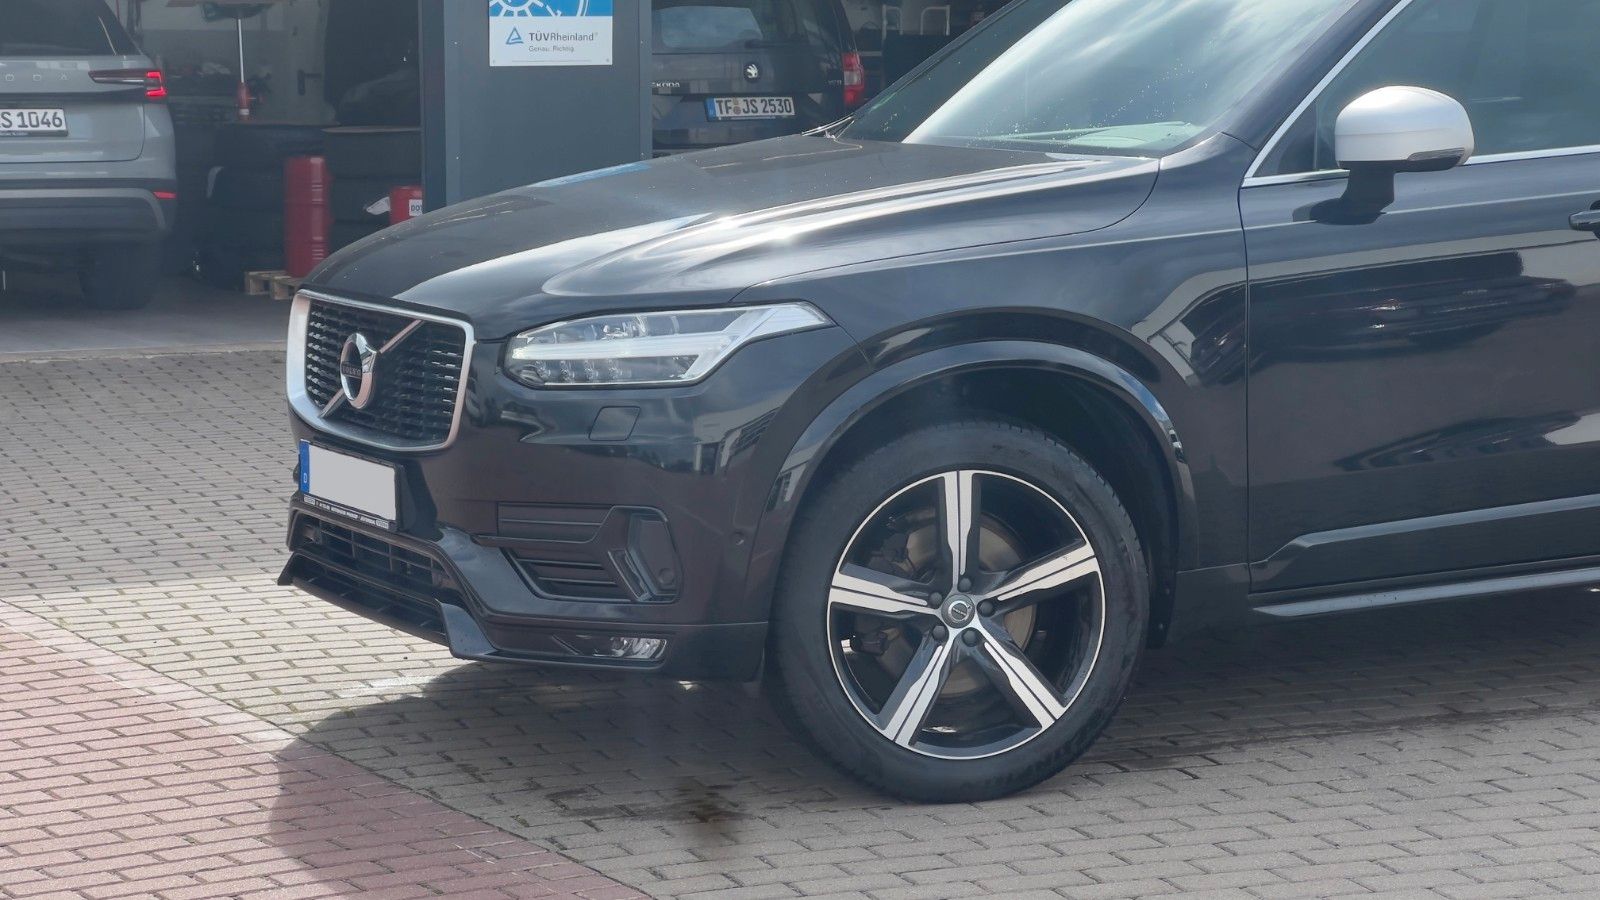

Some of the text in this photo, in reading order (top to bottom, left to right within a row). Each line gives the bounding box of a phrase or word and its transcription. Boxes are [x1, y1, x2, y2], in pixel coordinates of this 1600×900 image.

[716, 98, 792, 115] TF JS 2530
[0, 111, 63, 129] S 1046
